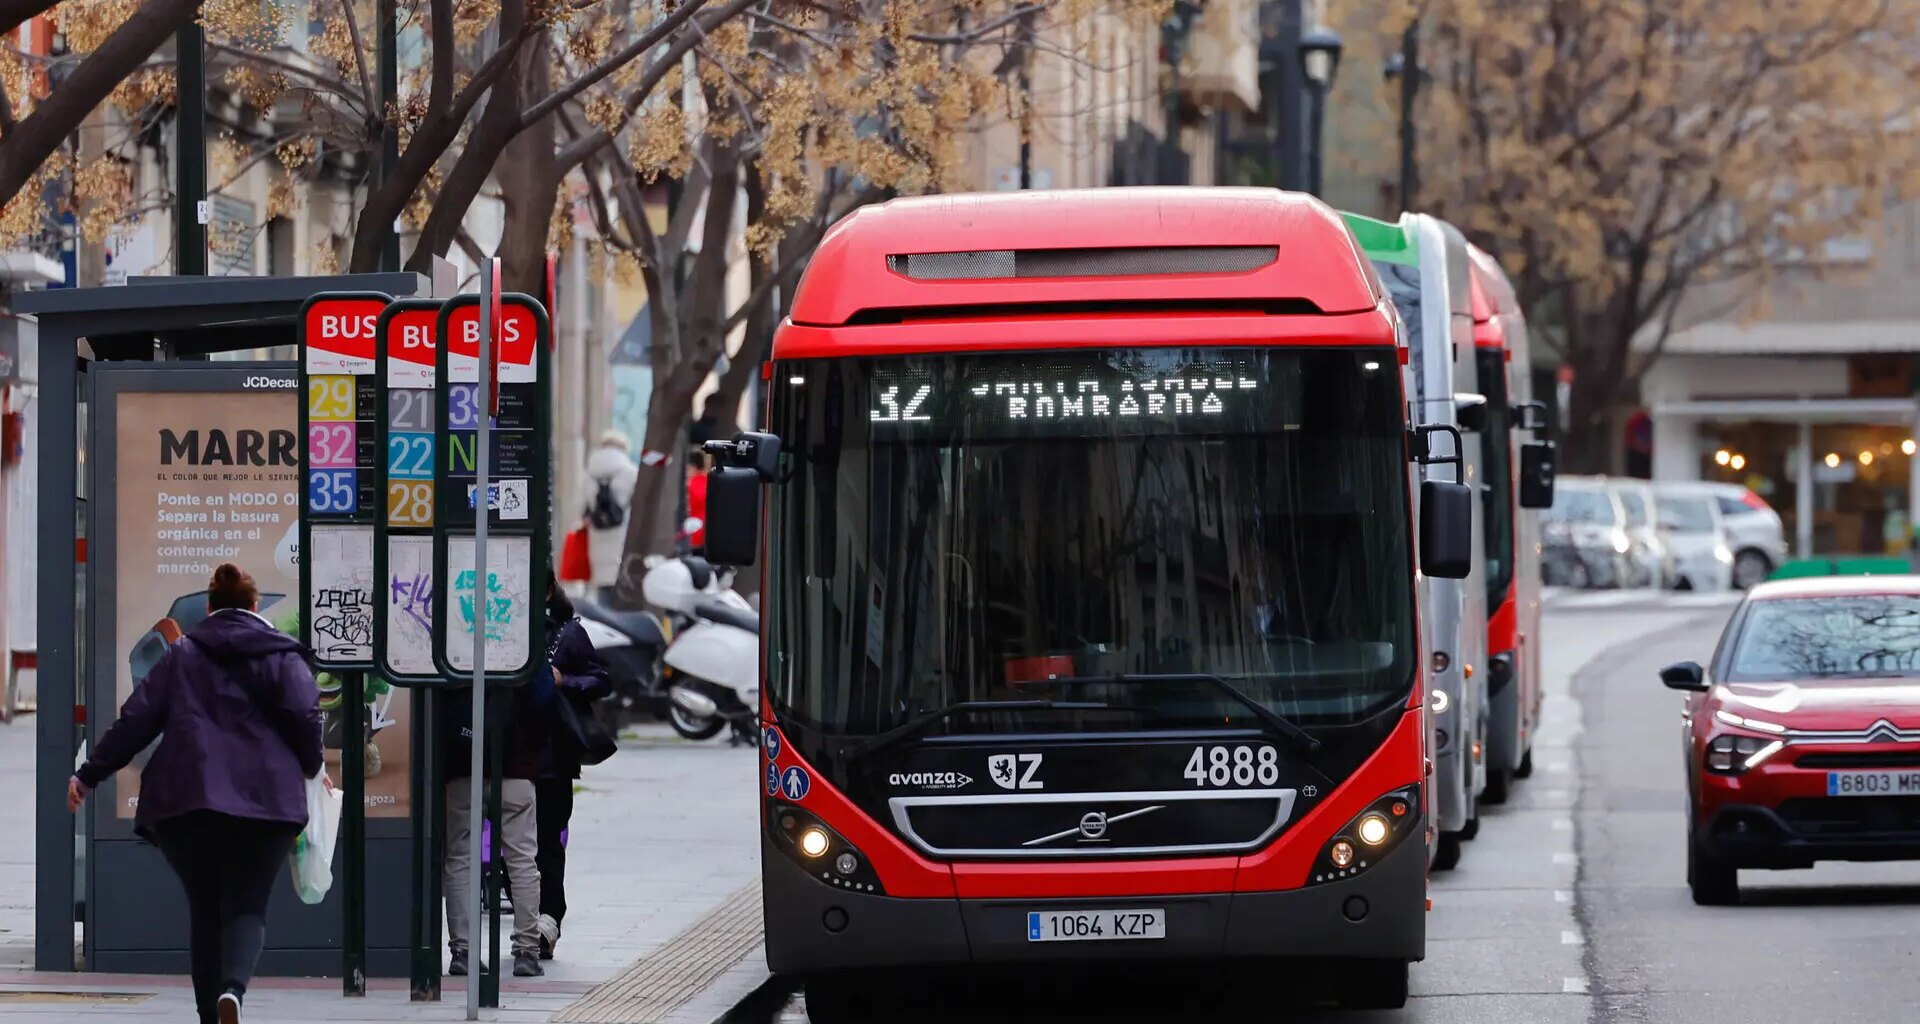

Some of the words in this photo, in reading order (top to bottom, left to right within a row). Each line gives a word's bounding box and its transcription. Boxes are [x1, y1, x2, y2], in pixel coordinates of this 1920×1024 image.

[322, 315, 376, 338] BUS
[463, 319, 519, 343] BS
[309, 379, 353, 417] 29
[391, 389, 428, 428] 21
[158, 428, 299, 467] MARR
[309, 425, 353, 464] 32
[388, 436, 432, 475] 22
[158, 473, 167, 481] EL
[173, 473, 198, 481] COLOR
[203, 473, 218, 481] QUE
[223, 473, 249, 481] MEJOR
[254, 473, 264, 481] LE
[269, 473, 299, 481] SIENTA
[158, 493, 200, 506] Ponte
[206, 495, 224, 506] en
[229, 493, 277, 506] MODO
[309, 472, 354, 511] 35
[389, 484, 432, 522] 28
[157, 510, 207, 524] Separa
[213, 510, 225, 523] la
[231, 510, 279, 523] basura
[157, 527, 218, 541] orgánica
[224, 530, 242, 540] en
[248, 528, 260, 540] el
[157, 544, 240, 557] contenedor
[1183, 745, 1279, 787] 4888
[889, 772, 955, 786] avanza
[1840, 774, 1890, 792] 6803
[1051, 914, 1103, 937] 1064
[1114, 913, 1155, 936] KZP
